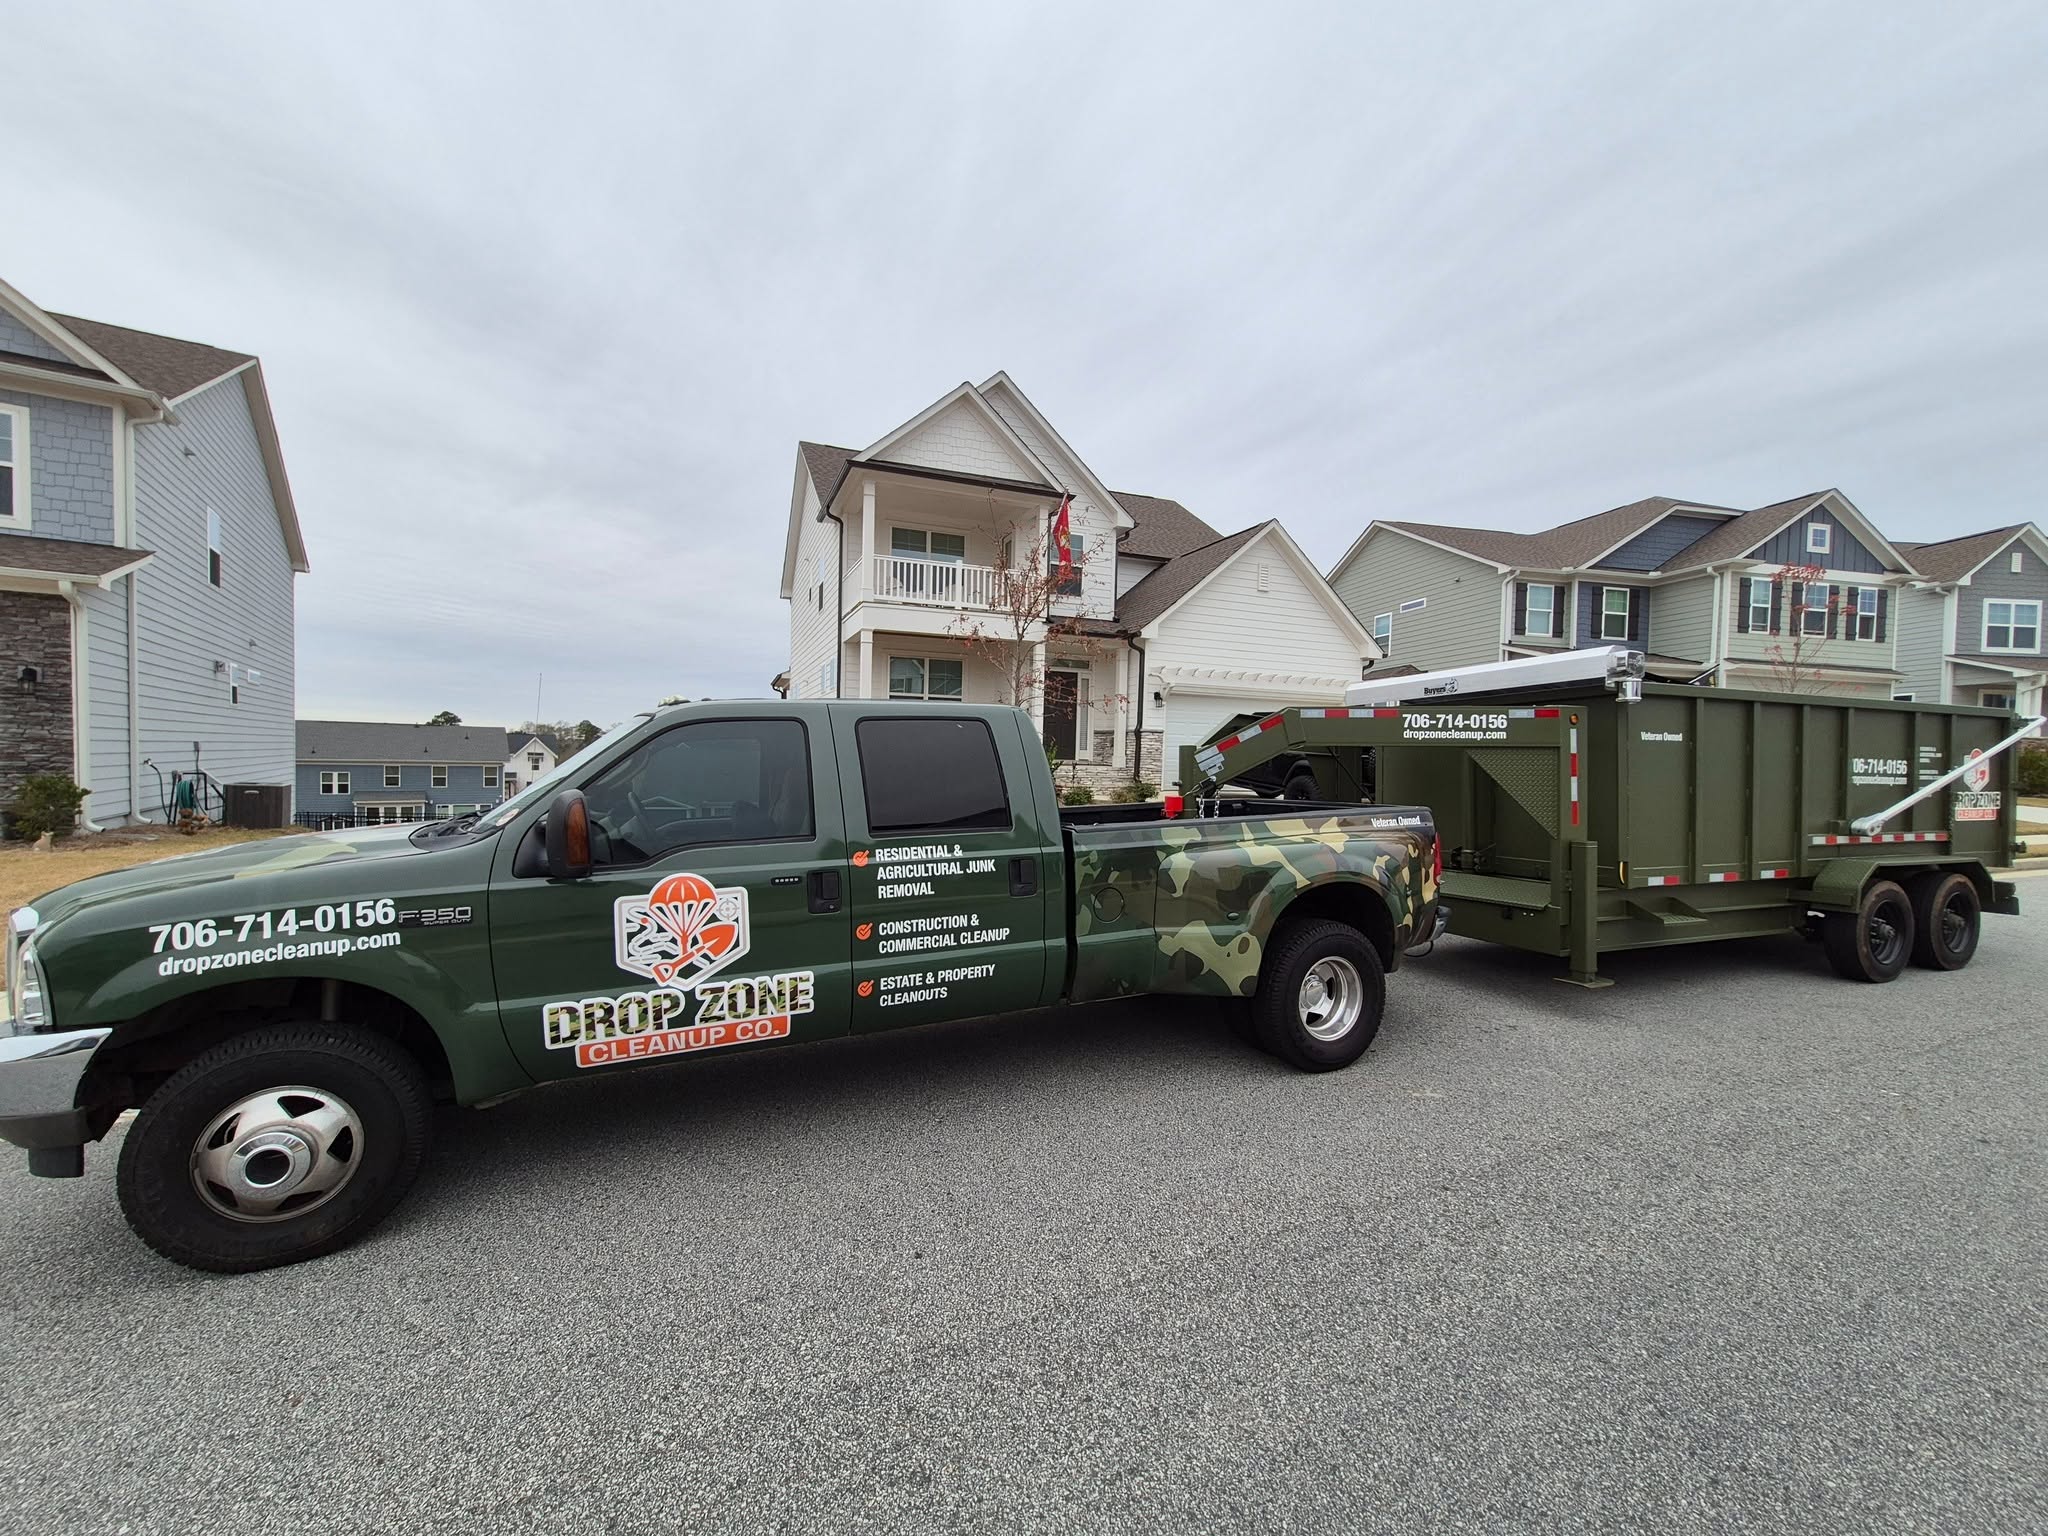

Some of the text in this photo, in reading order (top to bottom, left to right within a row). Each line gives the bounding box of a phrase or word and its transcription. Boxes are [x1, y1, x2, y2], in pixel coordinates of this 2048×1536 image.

[1402, 714, 1507, 728] 706-714-0156
[1403, 729, 1507, 740] dropzonecleanup.com
[1641, 731, 1662, 740] Veteran
[1852, 758, 1907, 774] 06-714-0156
[1371, 815, 1421, 827] Veteran Owned
[875, 844, 963, 862] RESIDENTIAL &
[877, 859, 996, 880] AGRICULTURAL JUNK
[878, 882, 935, 899] REMOVAL
[149, 898, 396, 953] 706-714-0156
[879, 914, 979, 935] CONSTRUCTION &
[879, 928, 1010, 953] COMMERCIAL CLEANUP
[158, 930, 401, 976] dropzonecleanup.com
[880, 964, 996, 990] ESTATE & PROPERTY
[879, 987, 948, 1007] CLEANOUTS
[545, 972, 813, 1048] DROP ZONE
[588, 1020, 781, 1063] CLEANUP CO.
